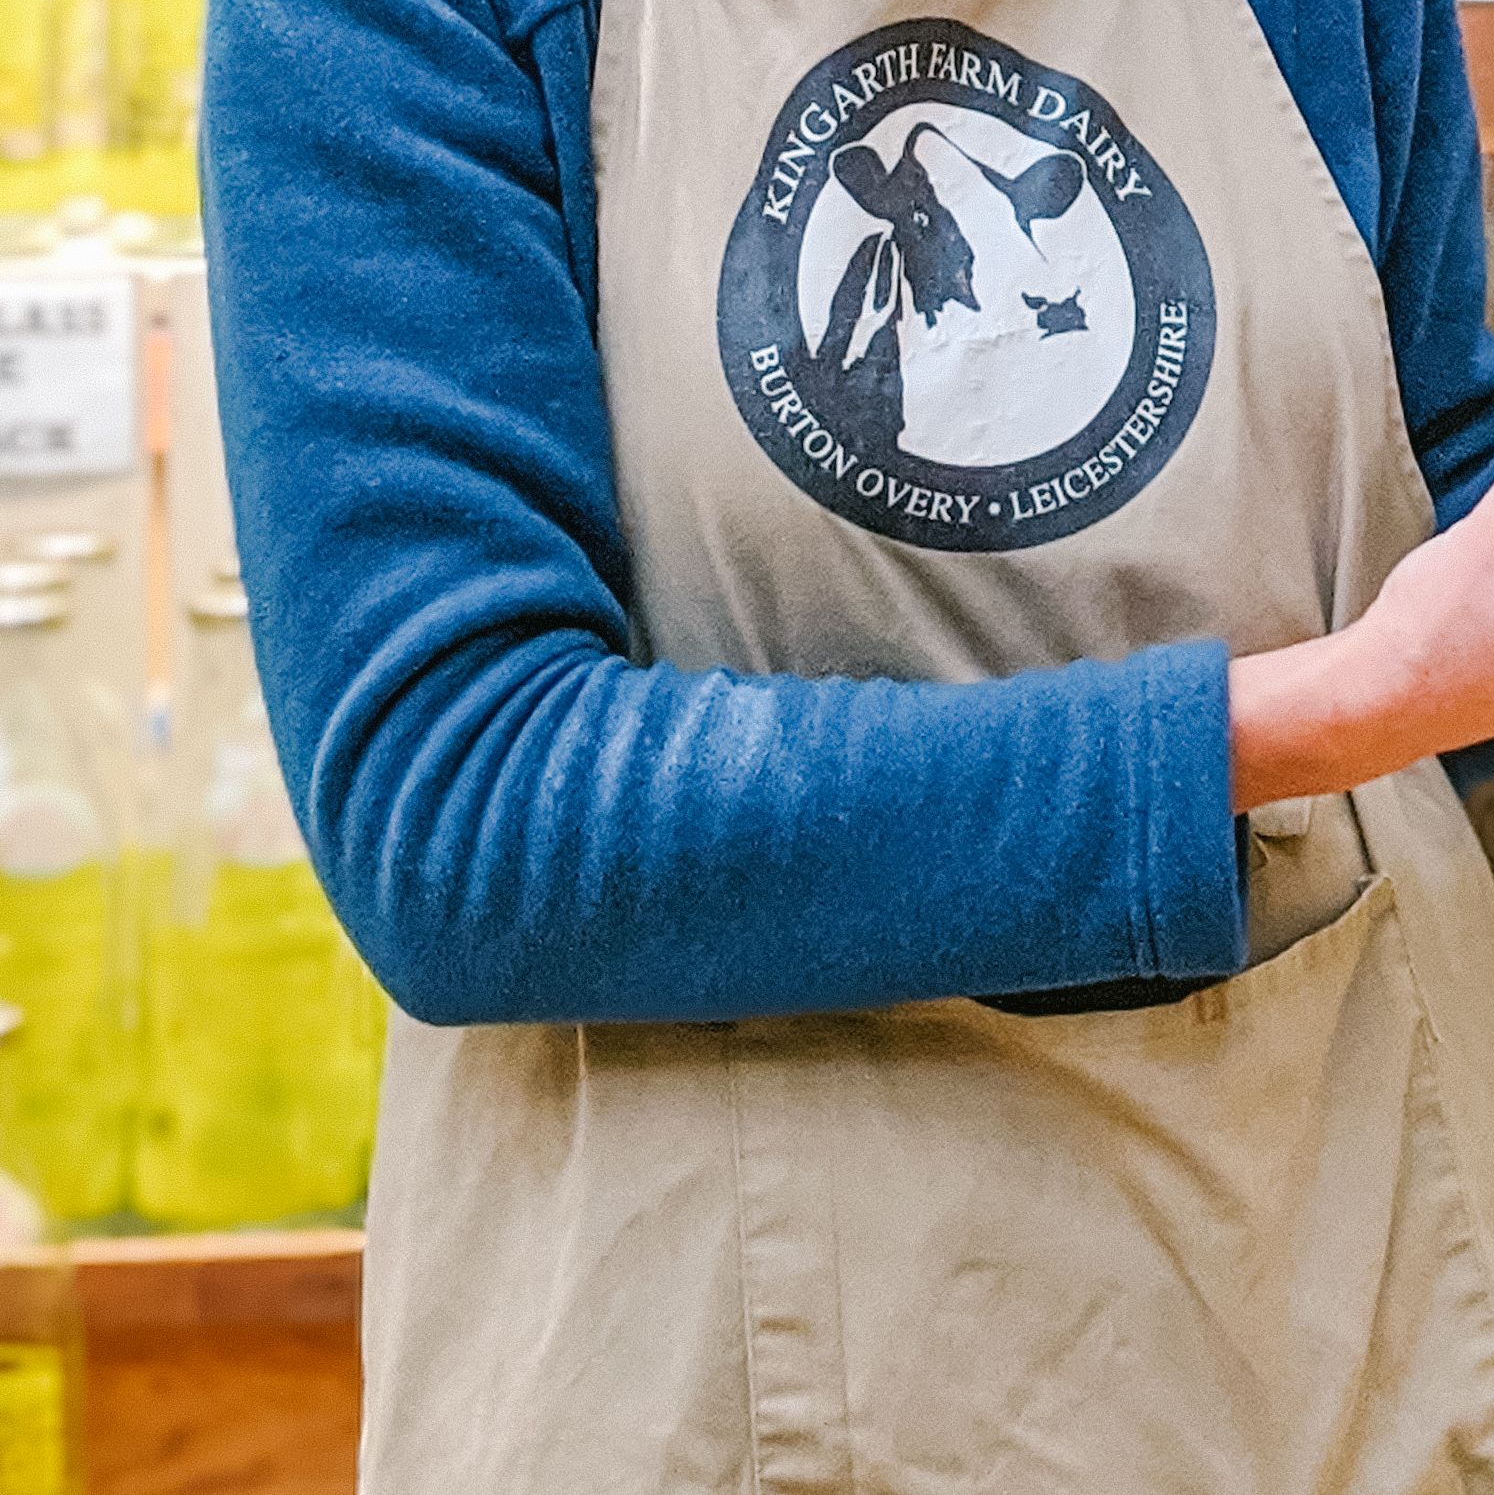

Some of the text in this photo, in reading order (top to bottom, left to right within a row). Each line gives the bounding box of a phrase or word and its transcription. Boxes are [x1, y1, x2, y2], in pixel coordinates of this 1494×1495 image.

[762, 43, 1154, 224] KINGARTH FARM DAIRY
[749, 301, 1190, 525] BURTON OVERY LEICESTERSHIRE
